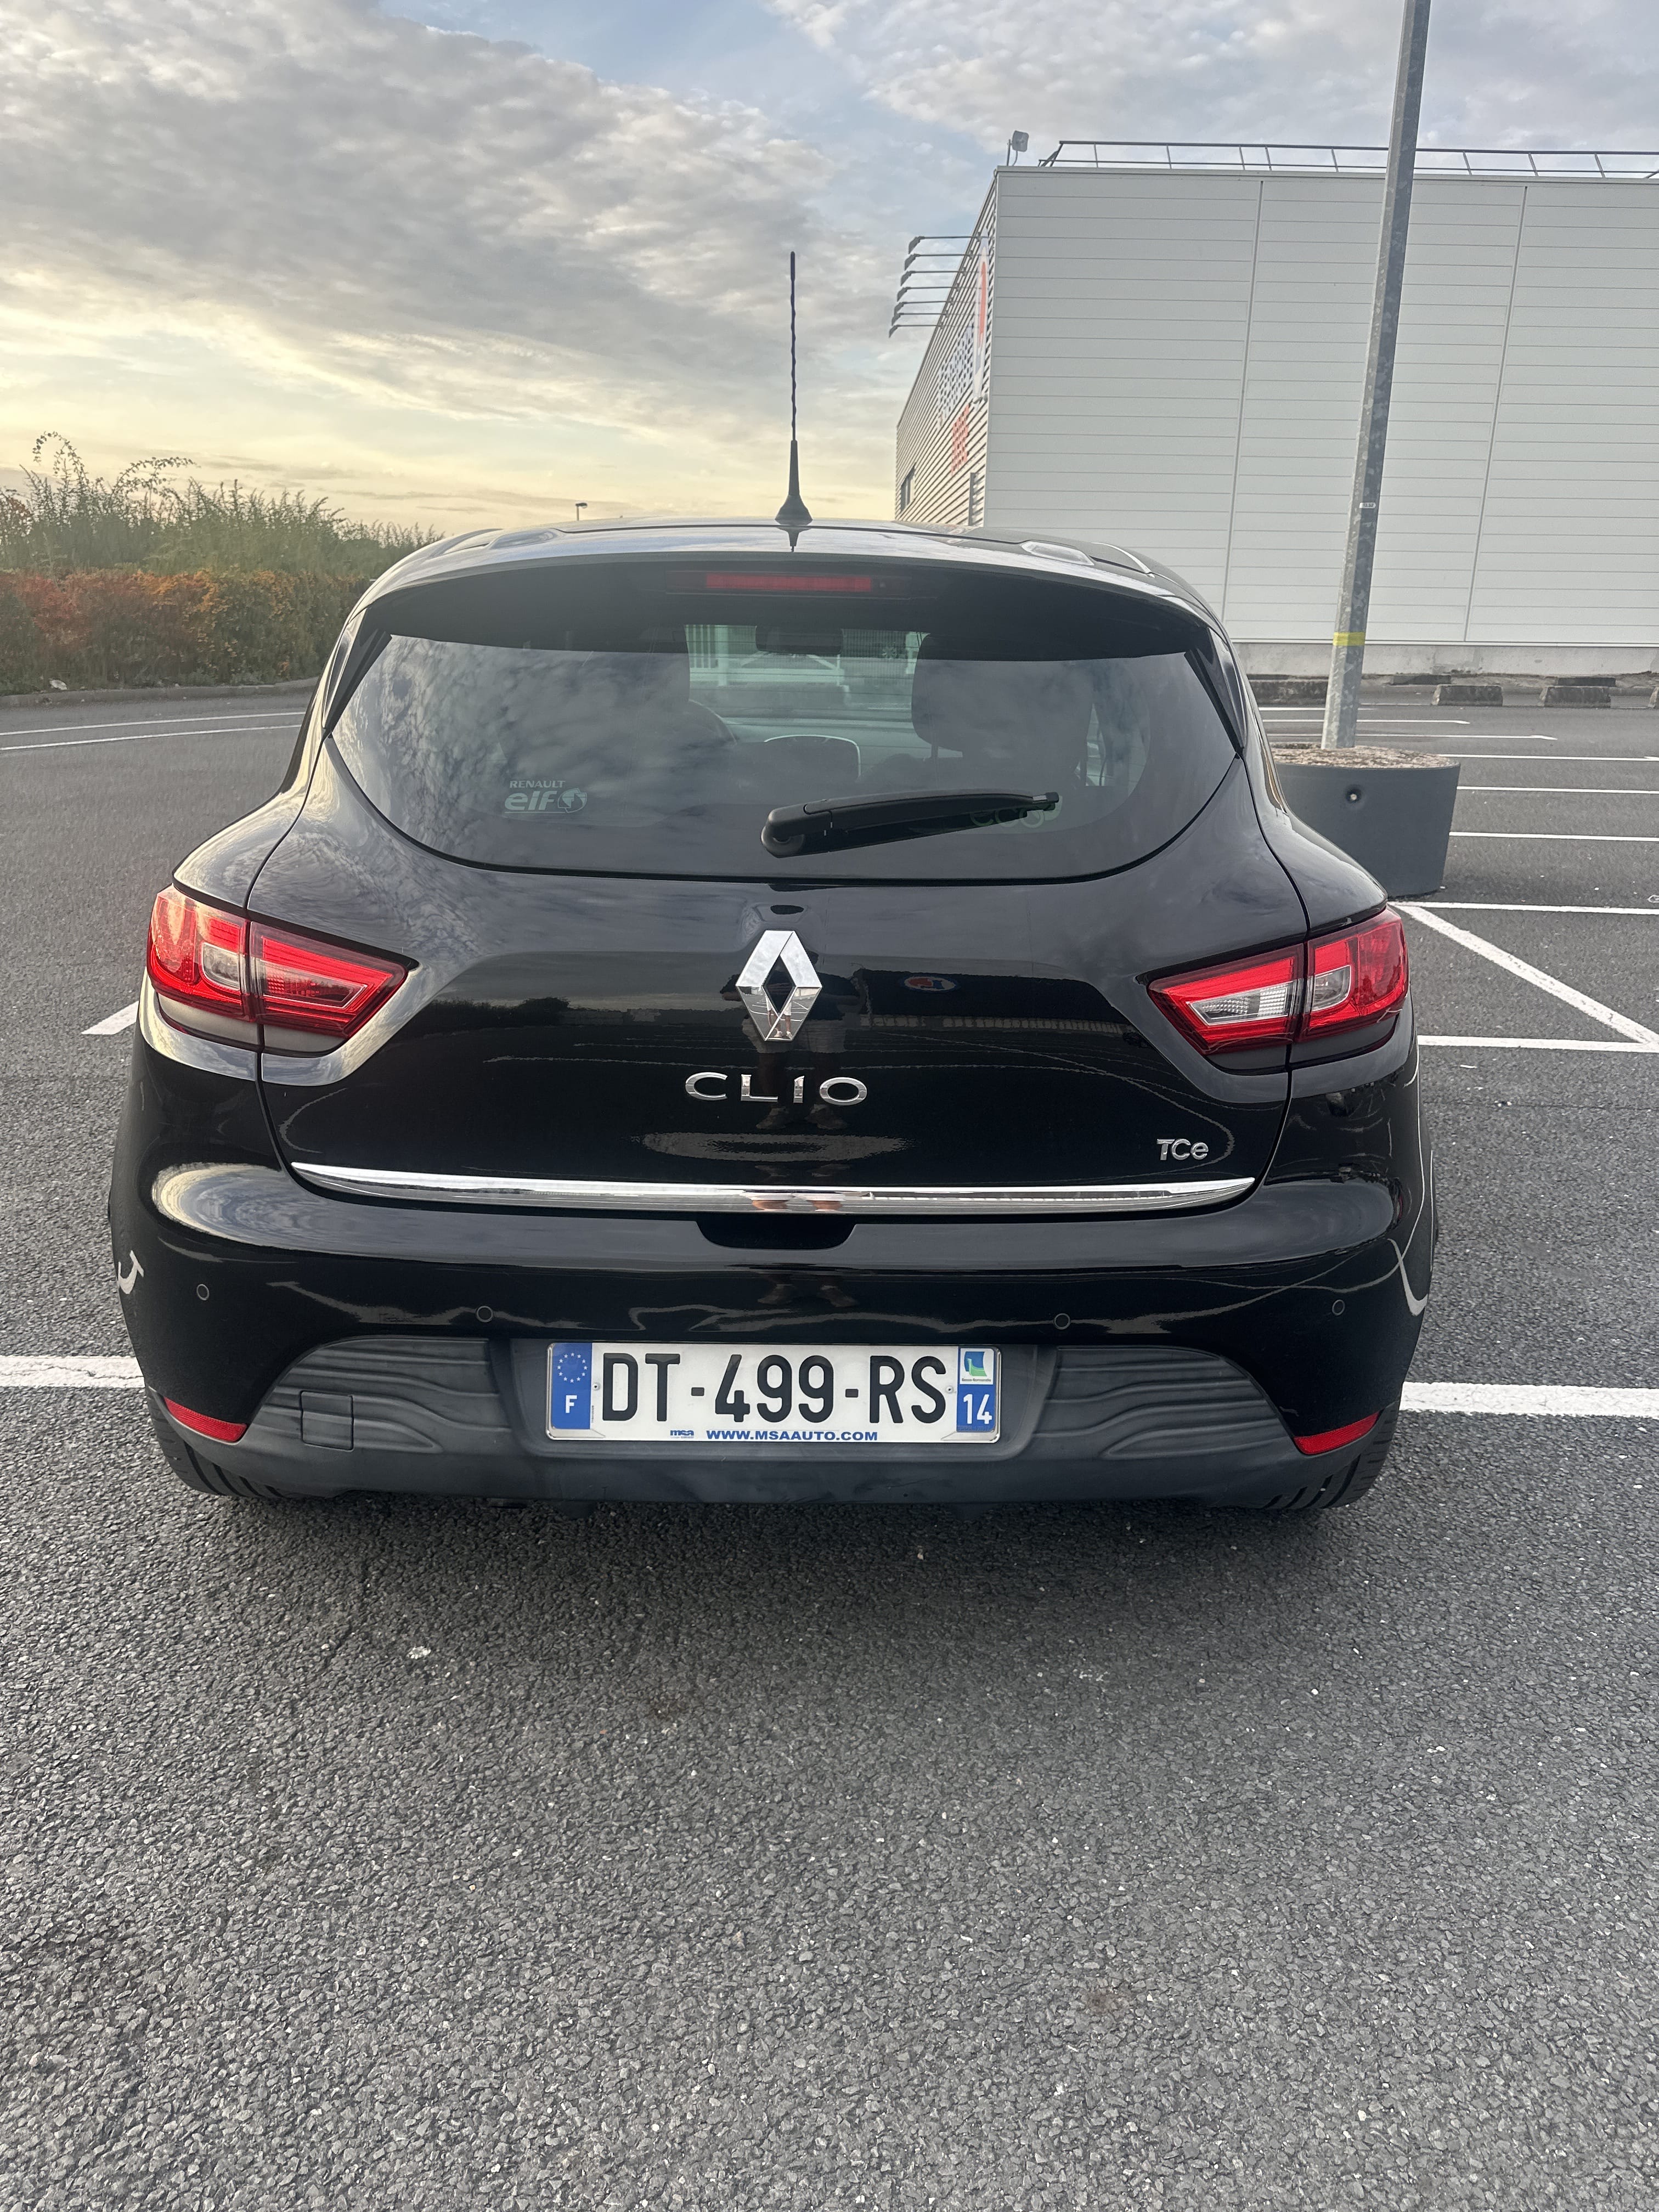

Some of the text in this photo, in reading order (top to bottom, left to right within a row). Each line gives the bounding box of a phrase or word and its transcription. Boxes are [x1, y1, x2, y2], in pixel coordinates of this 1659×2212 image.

[509, 780, 566, 788] RENAULT
[505, 791, 557, 811] elf
[685, 1072, 867, 1105] CLIO
[1156, 1138, 1209, 1161] TCe
[602, 1352, 947, 1424] DT-499-RS
[566, 1395, 578, 1414] F
[963, 1393, 992, 1425] 14
[706, 1430, 878, 1441] WWW.MSAAUTO.COM
